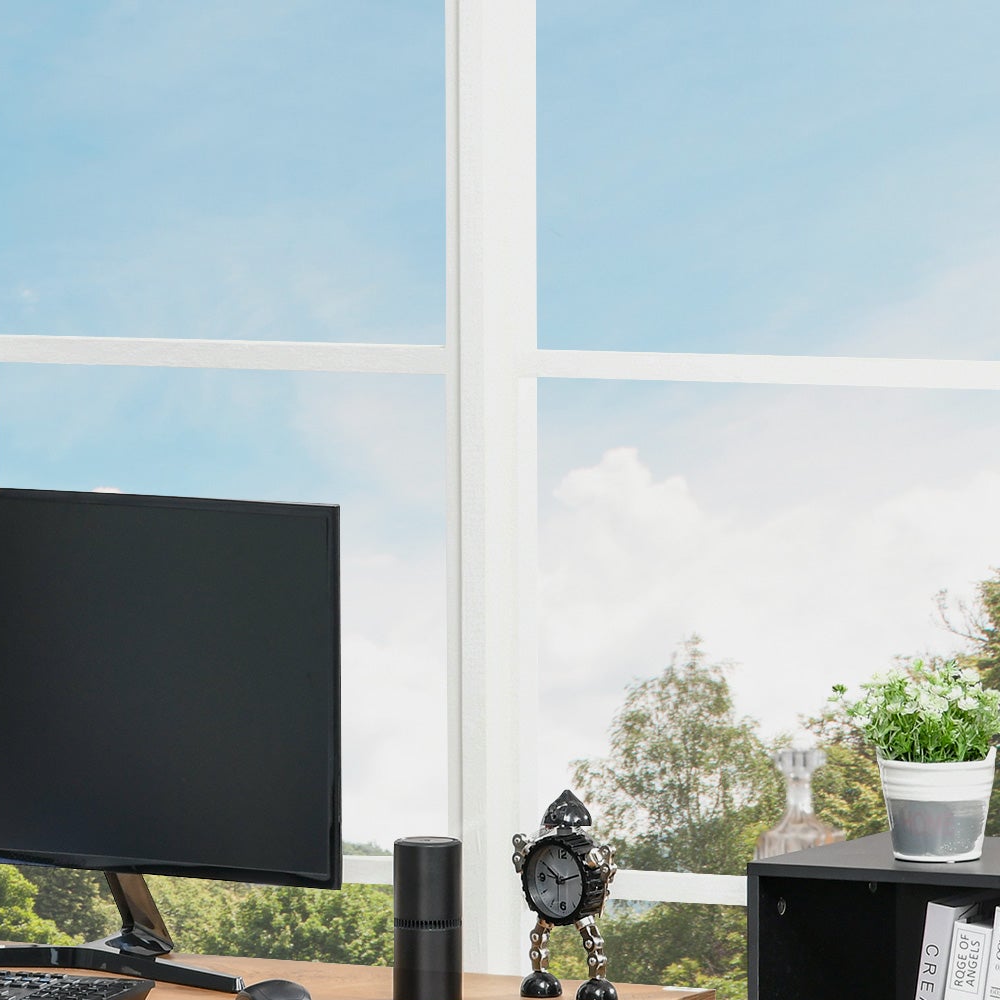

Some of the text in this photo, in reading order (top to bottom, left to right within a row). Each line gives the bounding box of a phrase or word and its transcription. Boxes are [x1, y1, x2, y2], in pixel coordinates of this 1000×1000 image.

[558, 849, 567, 859] 12
[560, 902, 566, 910] 6
[960, 934, 970, 949] OF
[966, 940, 980, 987] ANGELS
